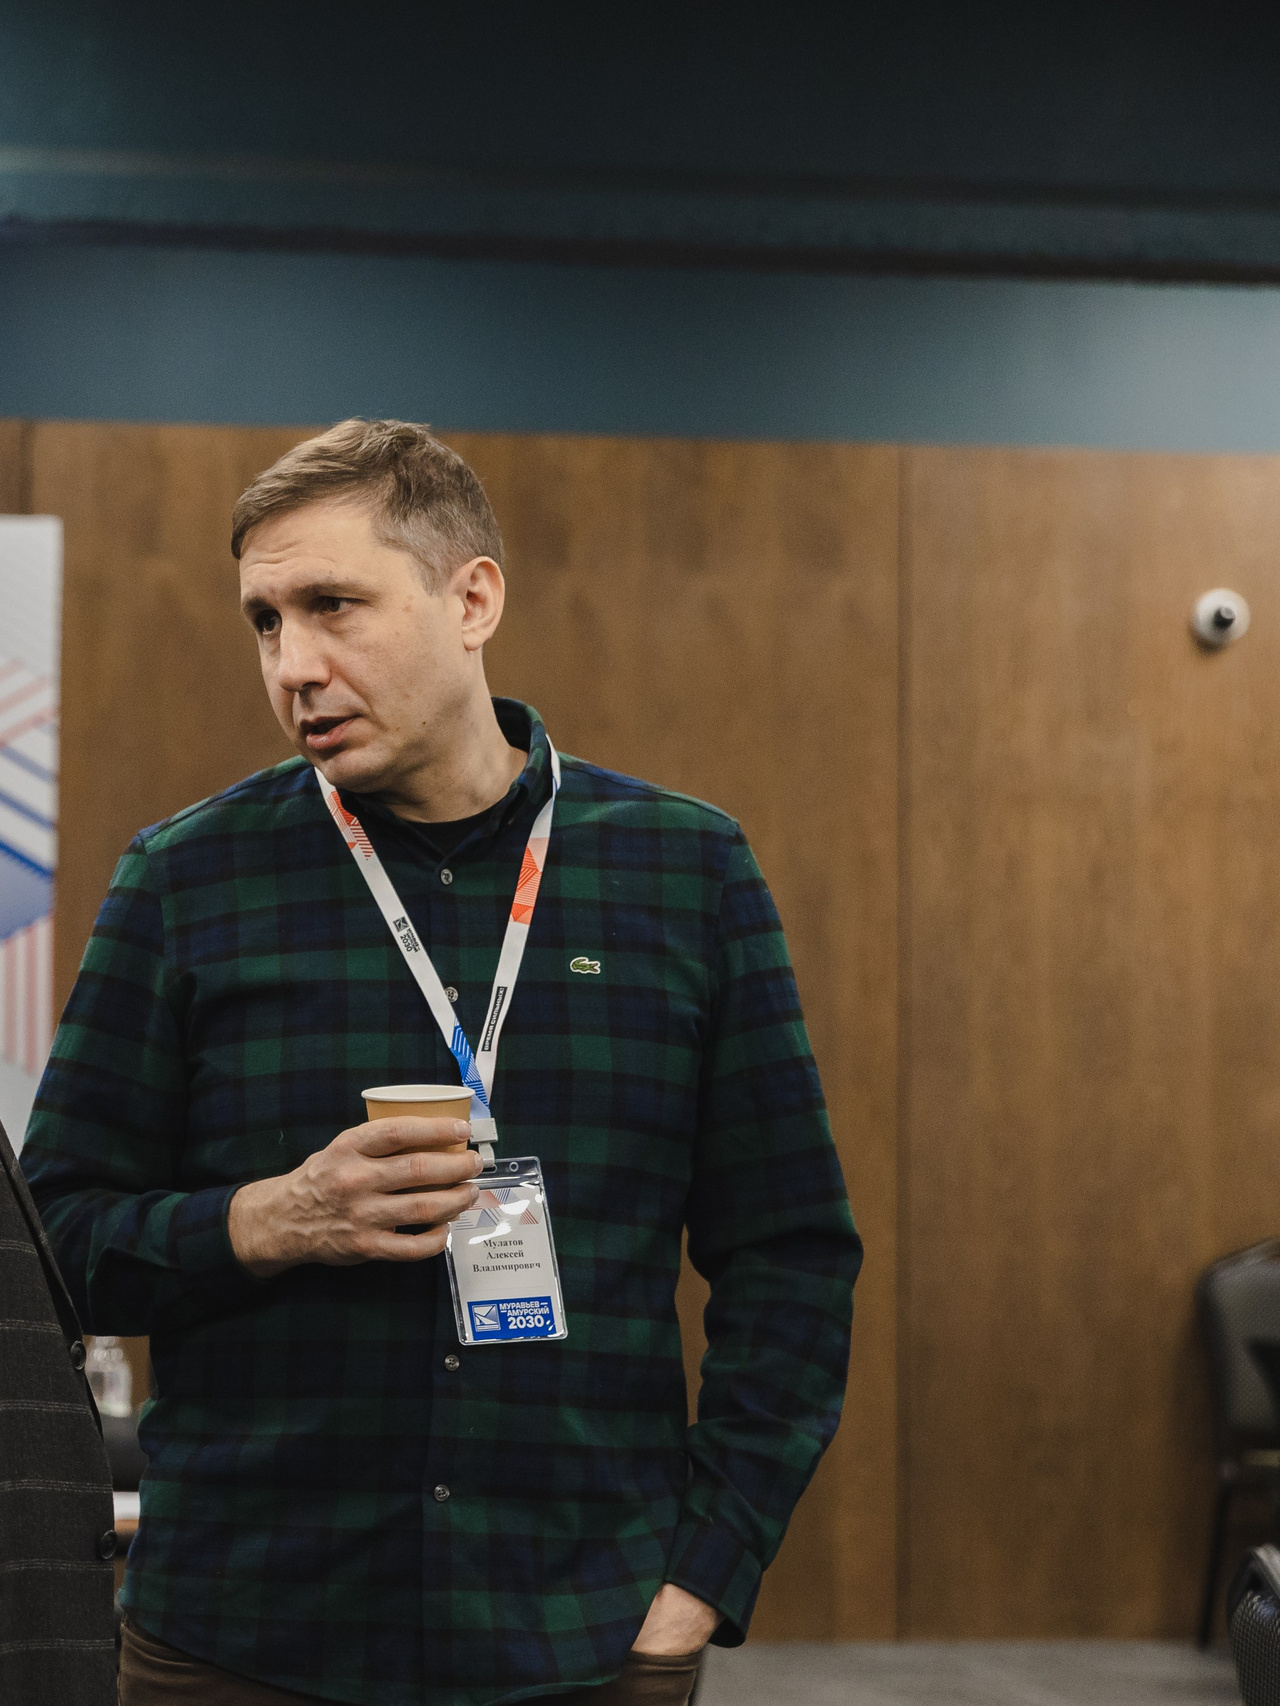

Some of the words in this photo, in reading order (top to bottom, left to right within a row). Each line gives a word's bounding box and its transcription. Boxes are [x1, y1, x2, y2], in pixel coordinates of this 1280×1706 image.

[400, 933, 413, 952] 2030
[483, 1239, 524, 1250] Мулатов
[486, 1249, 525, 1260] Алексей
[472, 1262, 541, 1272] Владимирович
[507, 1315, 545, 1330] 2030
